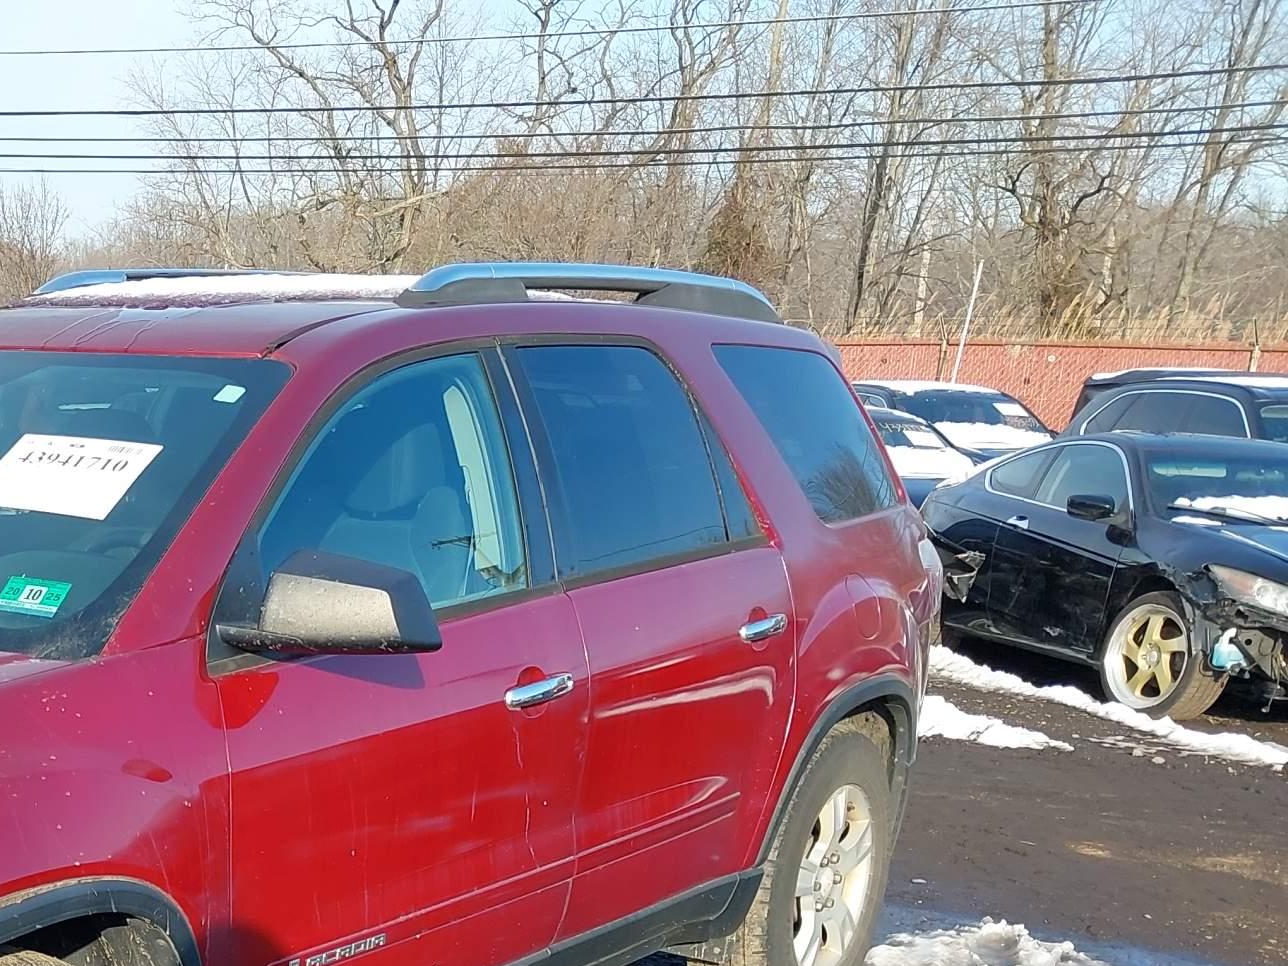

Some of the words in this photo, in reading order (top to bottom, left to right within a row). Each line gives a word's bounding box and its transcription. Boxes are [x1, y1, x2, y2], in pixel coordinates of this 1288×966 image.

[18, 451, 129, 472] 43941710
[5, 586, 21, 596] 20
[24, 588, 43, 601] 10
[45, 592, 62, 602] 25
